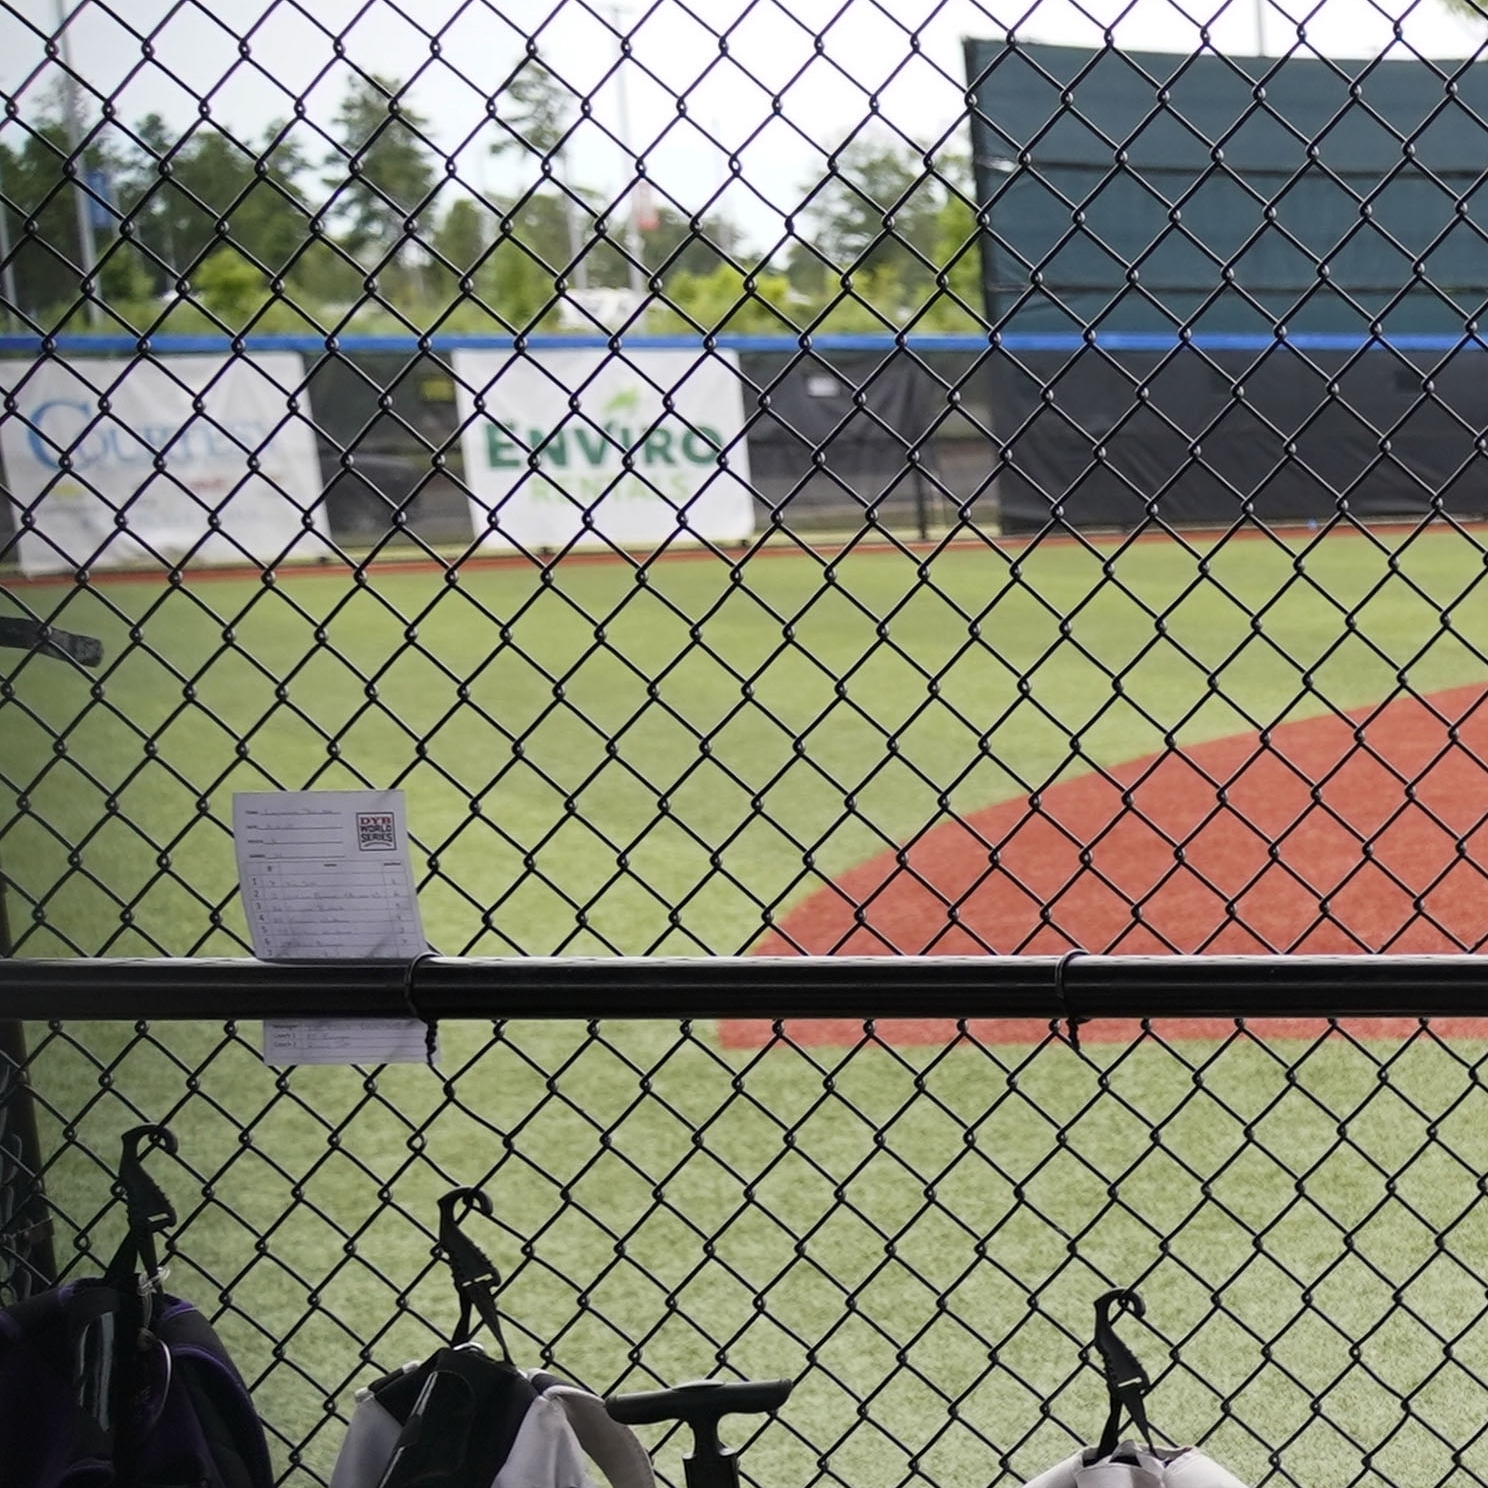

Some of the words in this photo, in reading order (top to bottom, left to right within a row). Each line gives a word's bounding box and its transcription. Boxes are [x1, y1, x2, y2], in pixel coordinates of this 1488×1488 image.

[484, 417, 724, 470] ENVIRO
[360, 824, 392, 833] WORLD
[361, 832, 393, 843] SERIES
